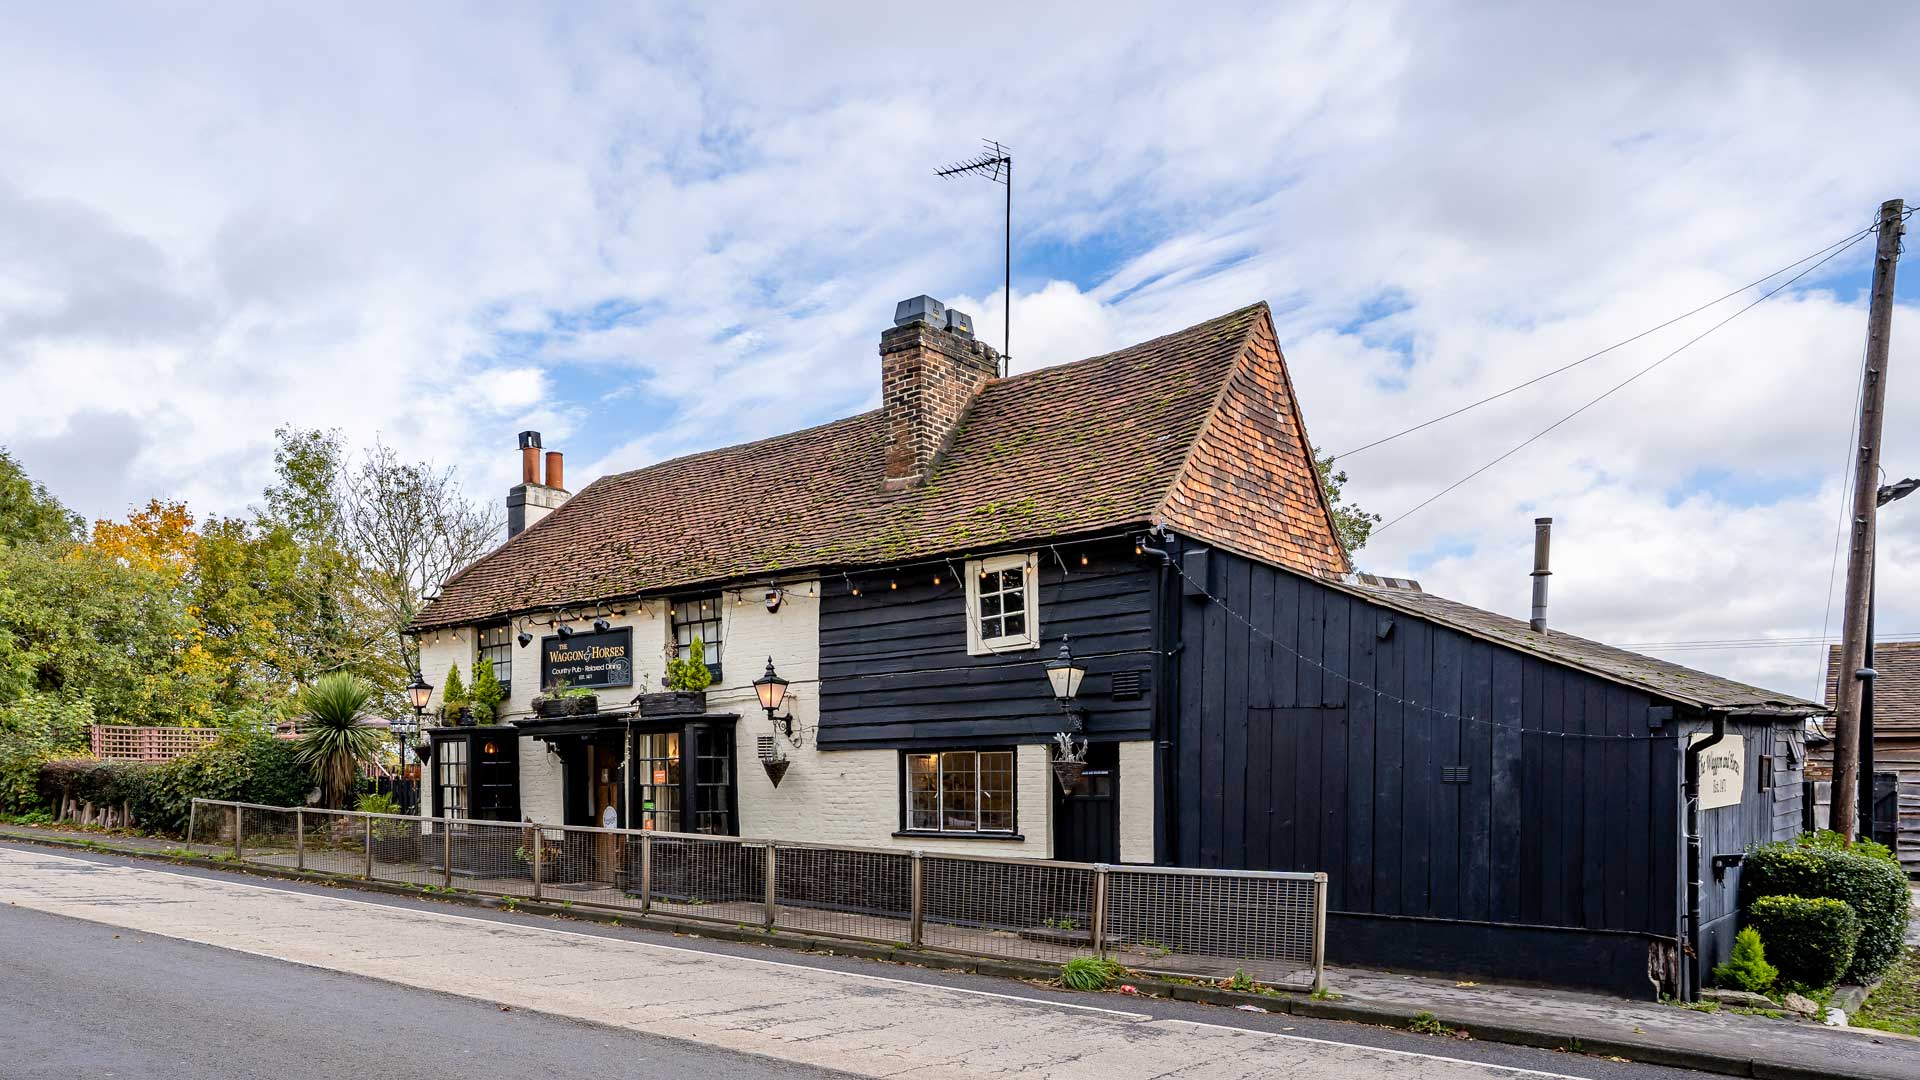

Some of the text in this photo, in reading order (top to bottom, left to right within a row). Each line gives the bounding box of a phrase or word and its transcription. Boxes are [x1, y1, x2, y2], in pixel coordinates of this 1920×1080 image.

[550, 650, 584, 663] WAGGON
[592, 646, 624, 659] HORSES
[584, 664, 605, 672] Relaxed
[605, 663, 621, 671] Dining
